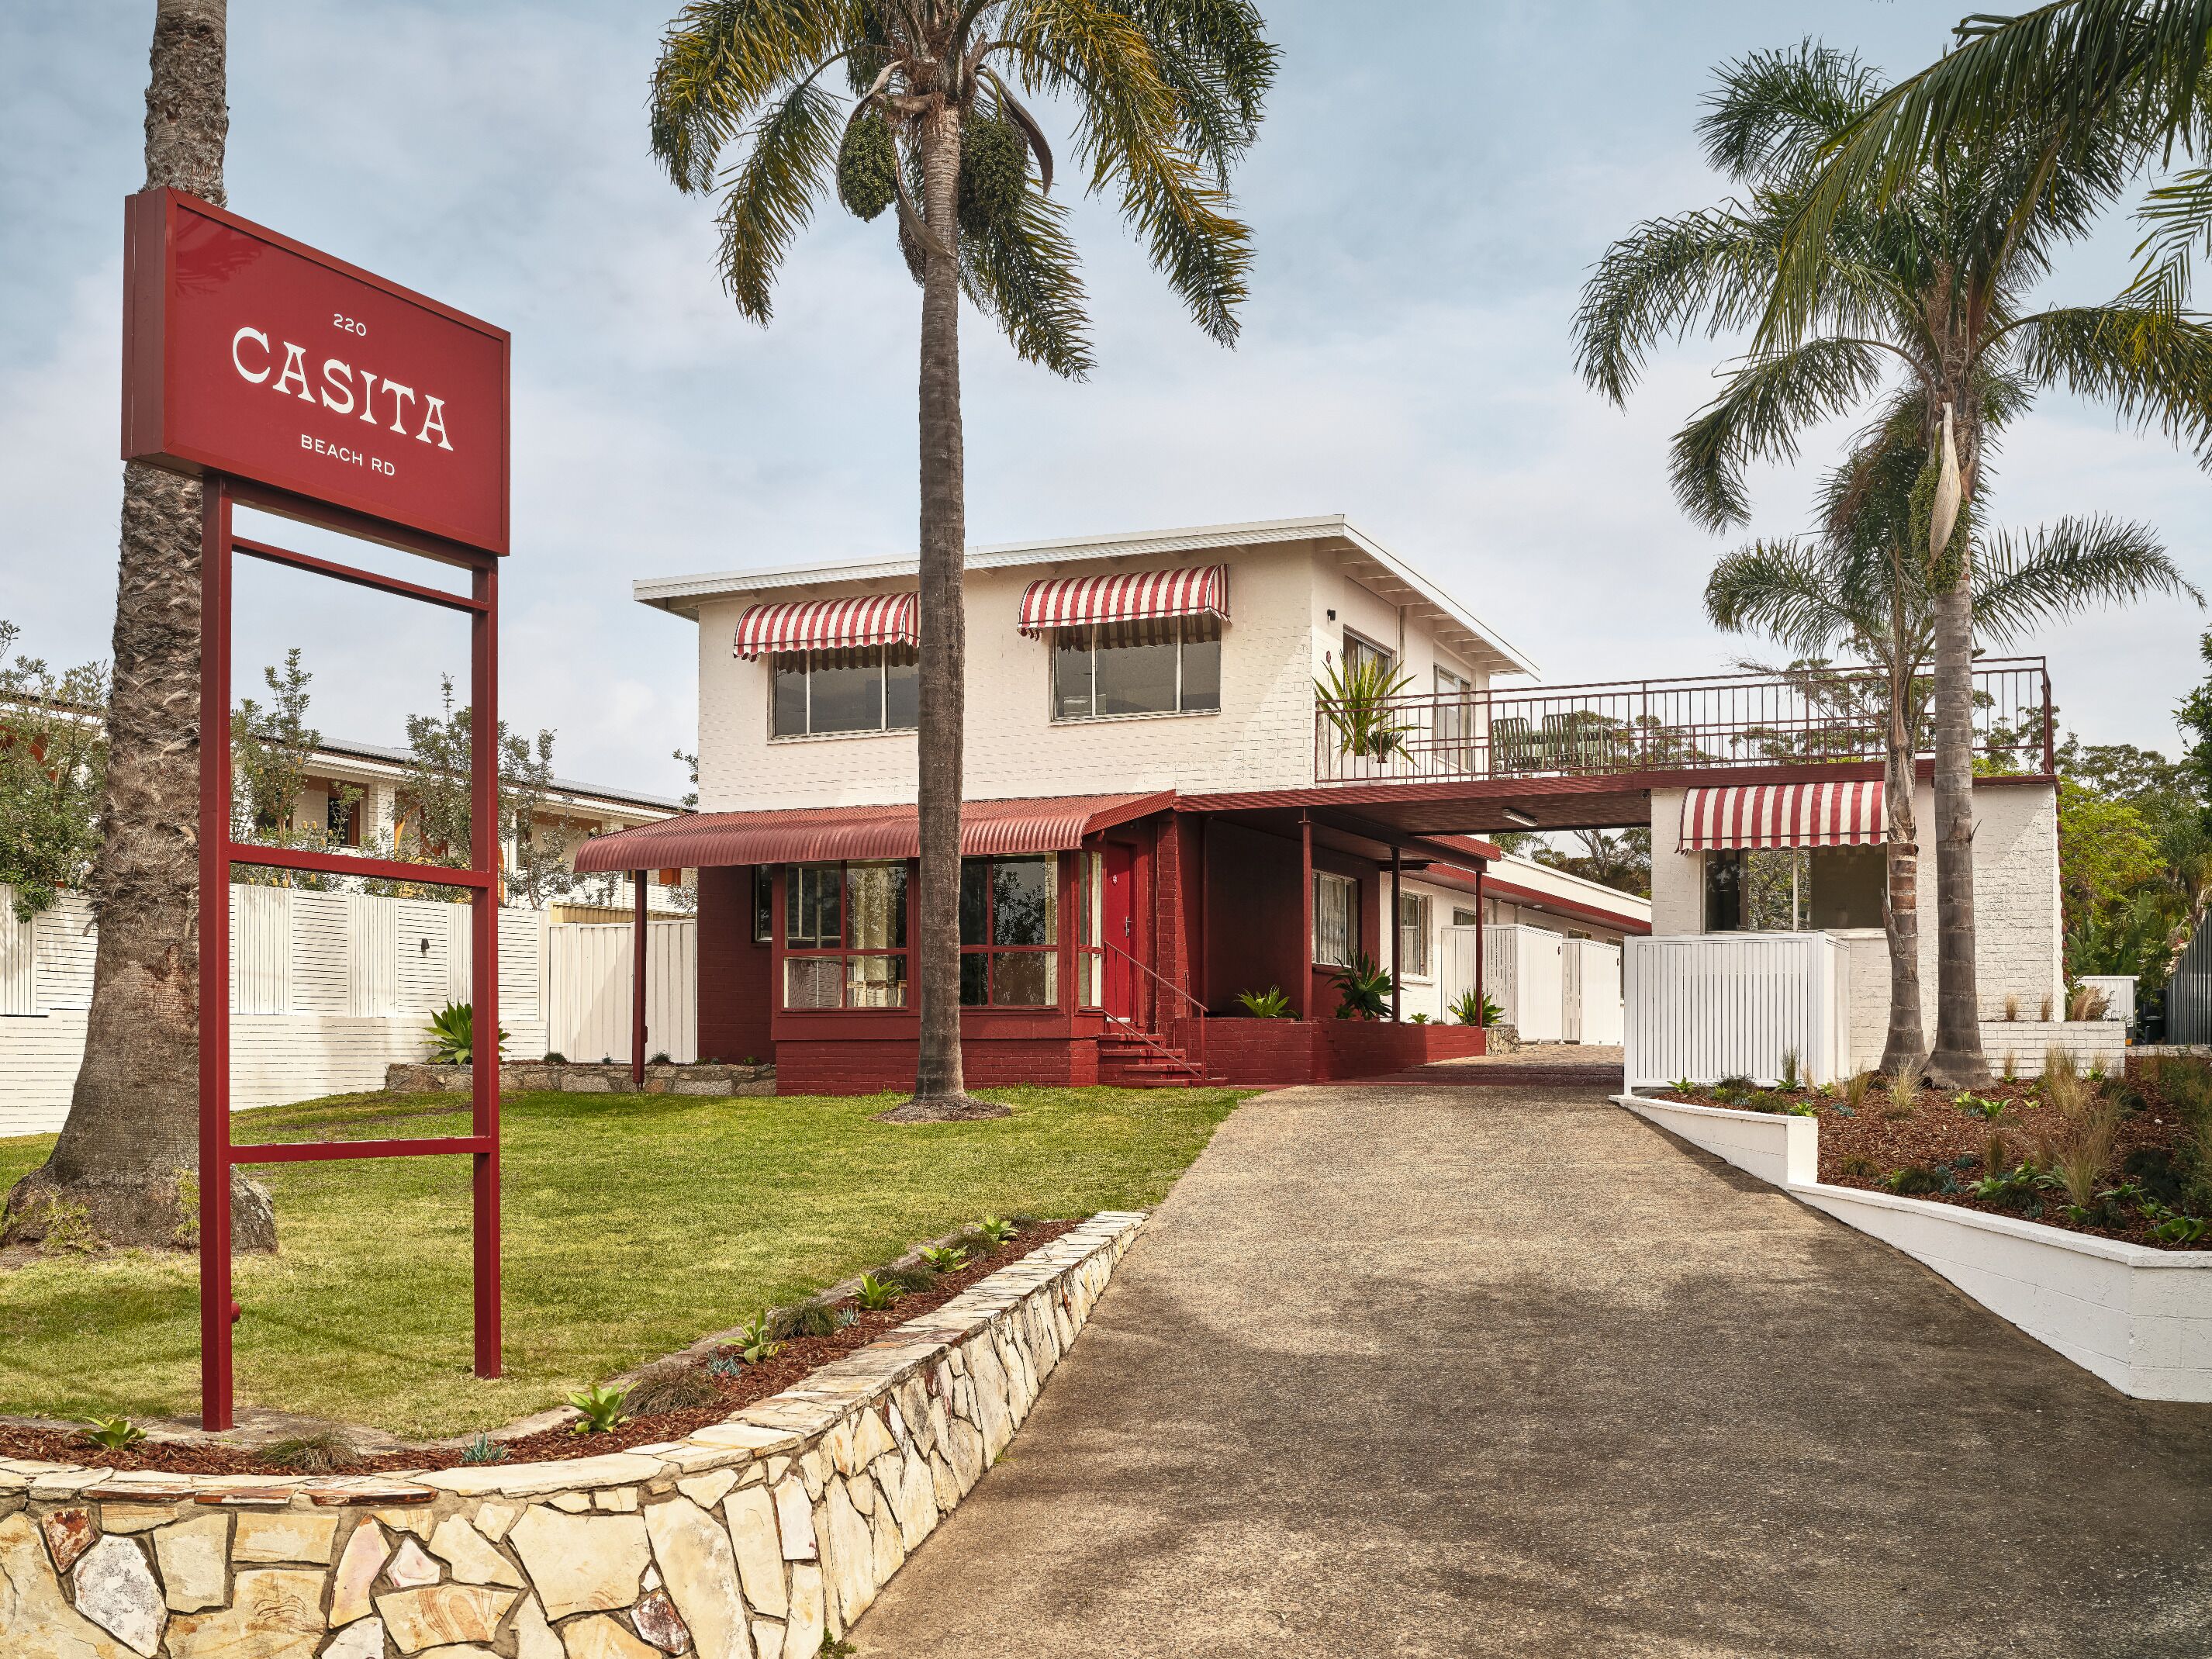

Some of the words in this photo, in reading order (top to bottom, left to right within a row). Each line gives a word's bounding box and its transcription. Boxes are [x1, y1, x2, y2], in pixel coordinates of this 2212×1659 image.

[333, 313, 367, 337] 220
[232, 327, 454, 451] CASITA
[301, 434, 363, 467] BEACH
[372, 457, 396, 476] RD
